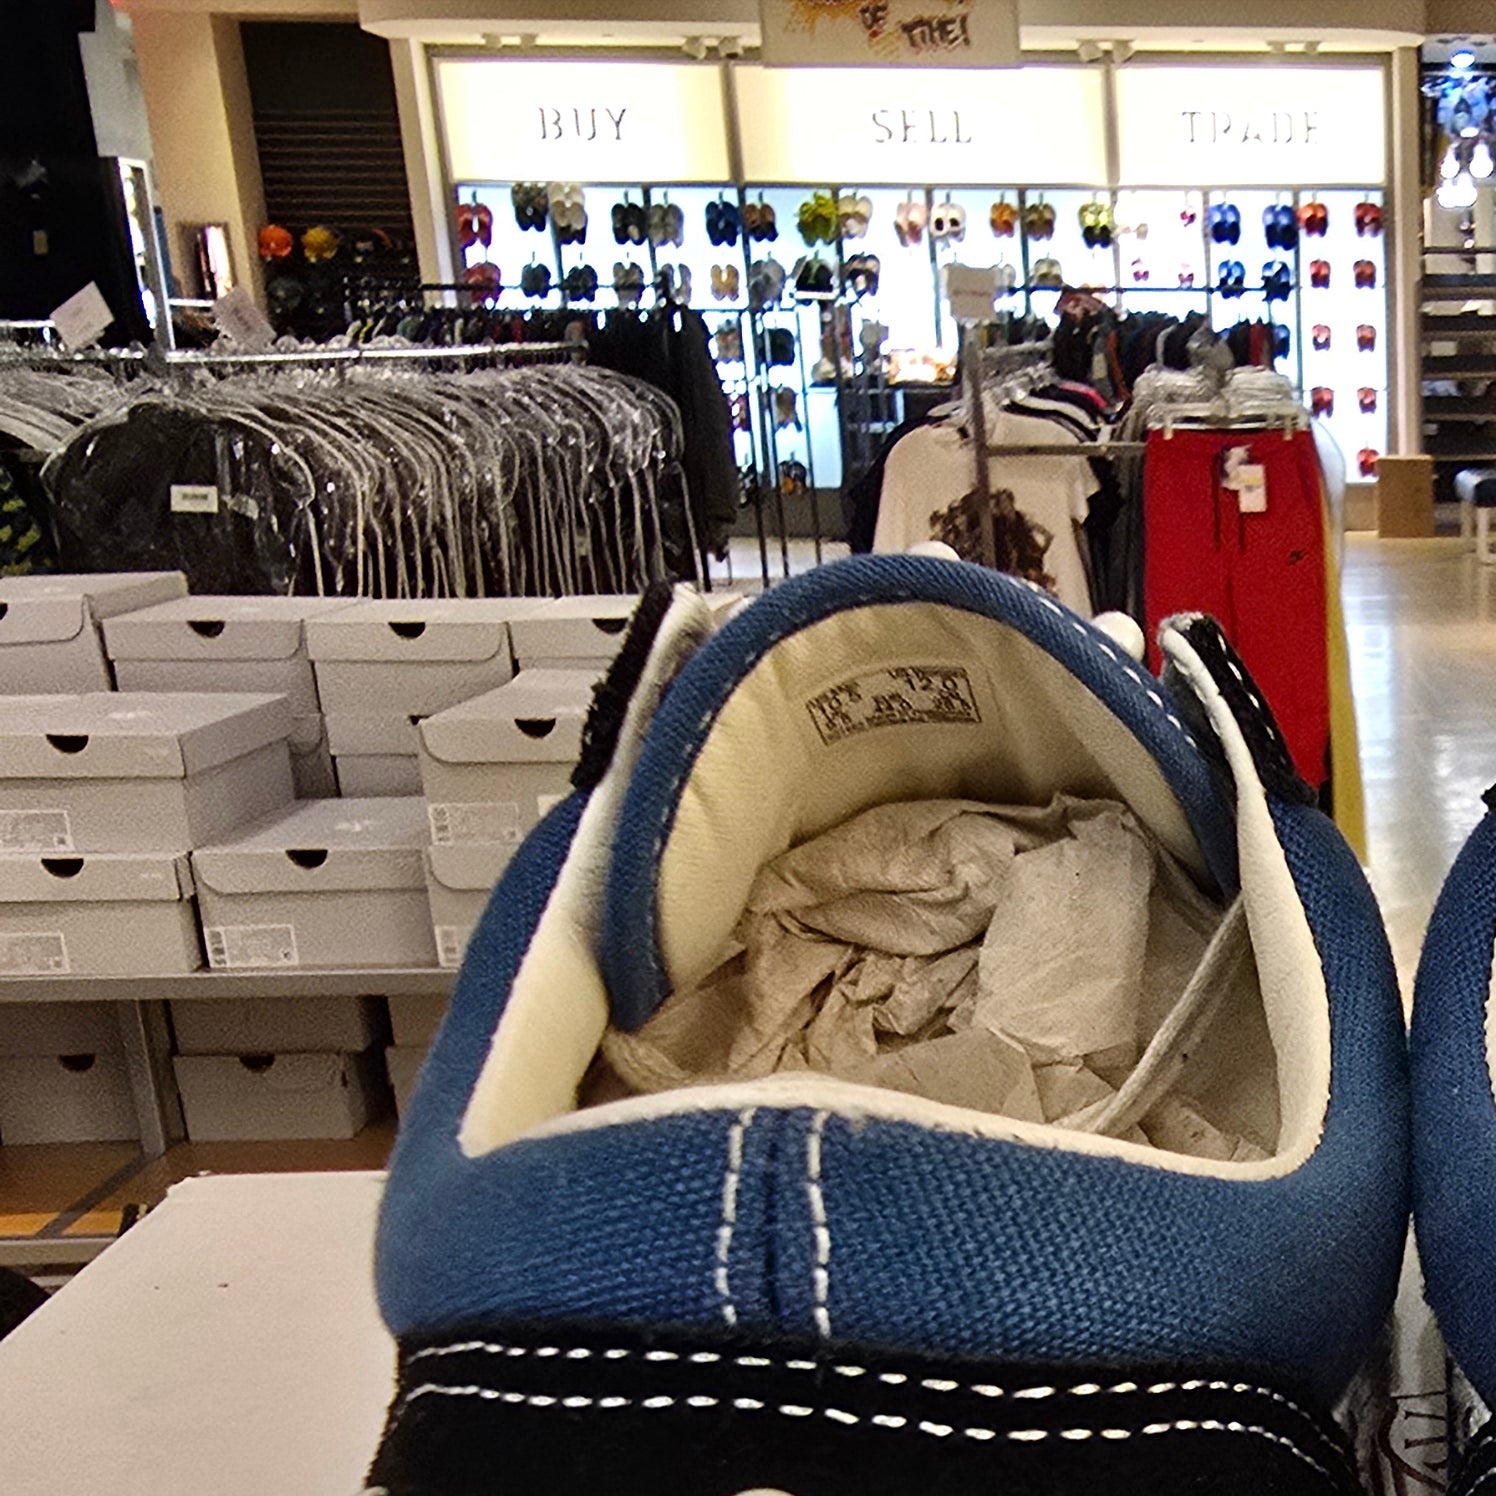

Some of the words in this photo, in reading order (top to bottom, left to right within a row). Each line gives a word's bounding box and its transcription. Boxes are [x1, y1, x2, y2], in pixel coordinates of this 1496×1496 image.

[538, 107, 627, 141] BUY
[872, 109, 972, 143] SELL
[1181, 111, 1318, 143] TRADE
